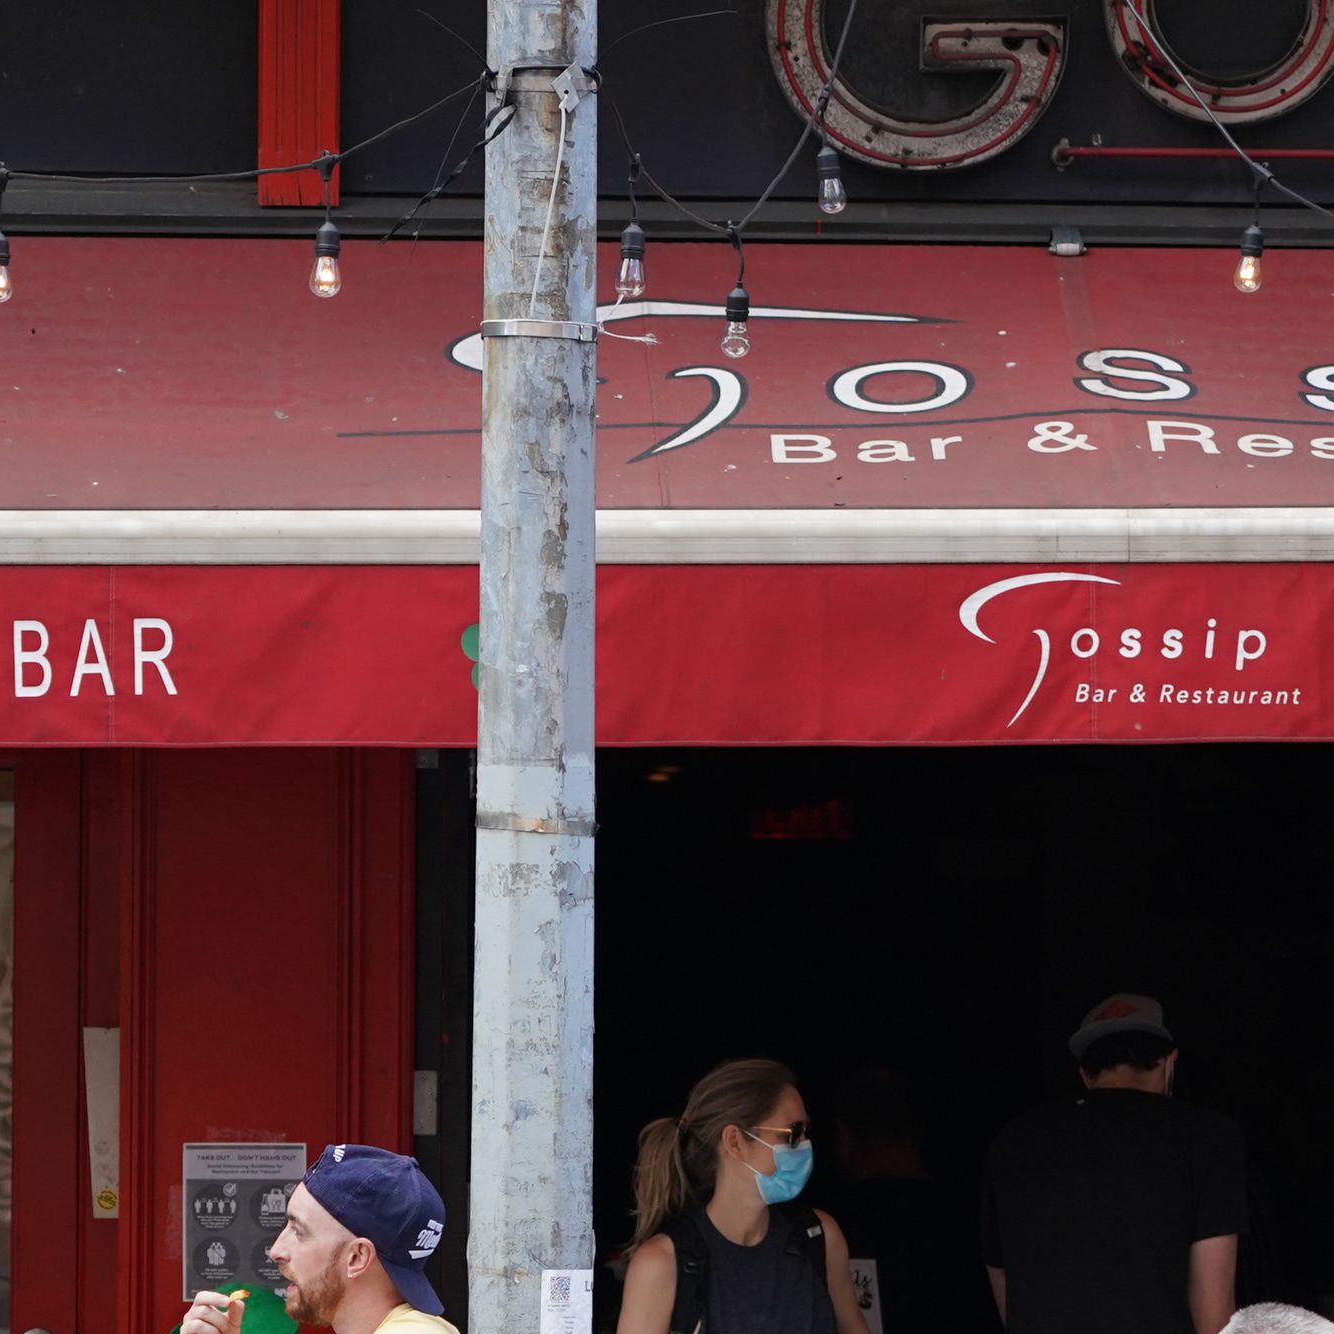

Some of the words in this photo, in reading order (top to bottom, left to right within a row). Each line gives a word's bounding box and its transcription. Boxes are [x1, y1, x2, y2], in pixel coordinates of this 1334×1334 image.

[770, 431, 964, 465] Bar
[1027, 419, 1099, 455] &
[13, 617, 179, 698] BAR
[1074, 683, 1118, 704] Bar
[1129, 683, 1146, 704] &
[1159, 683, 1302, 706] Restaurant
